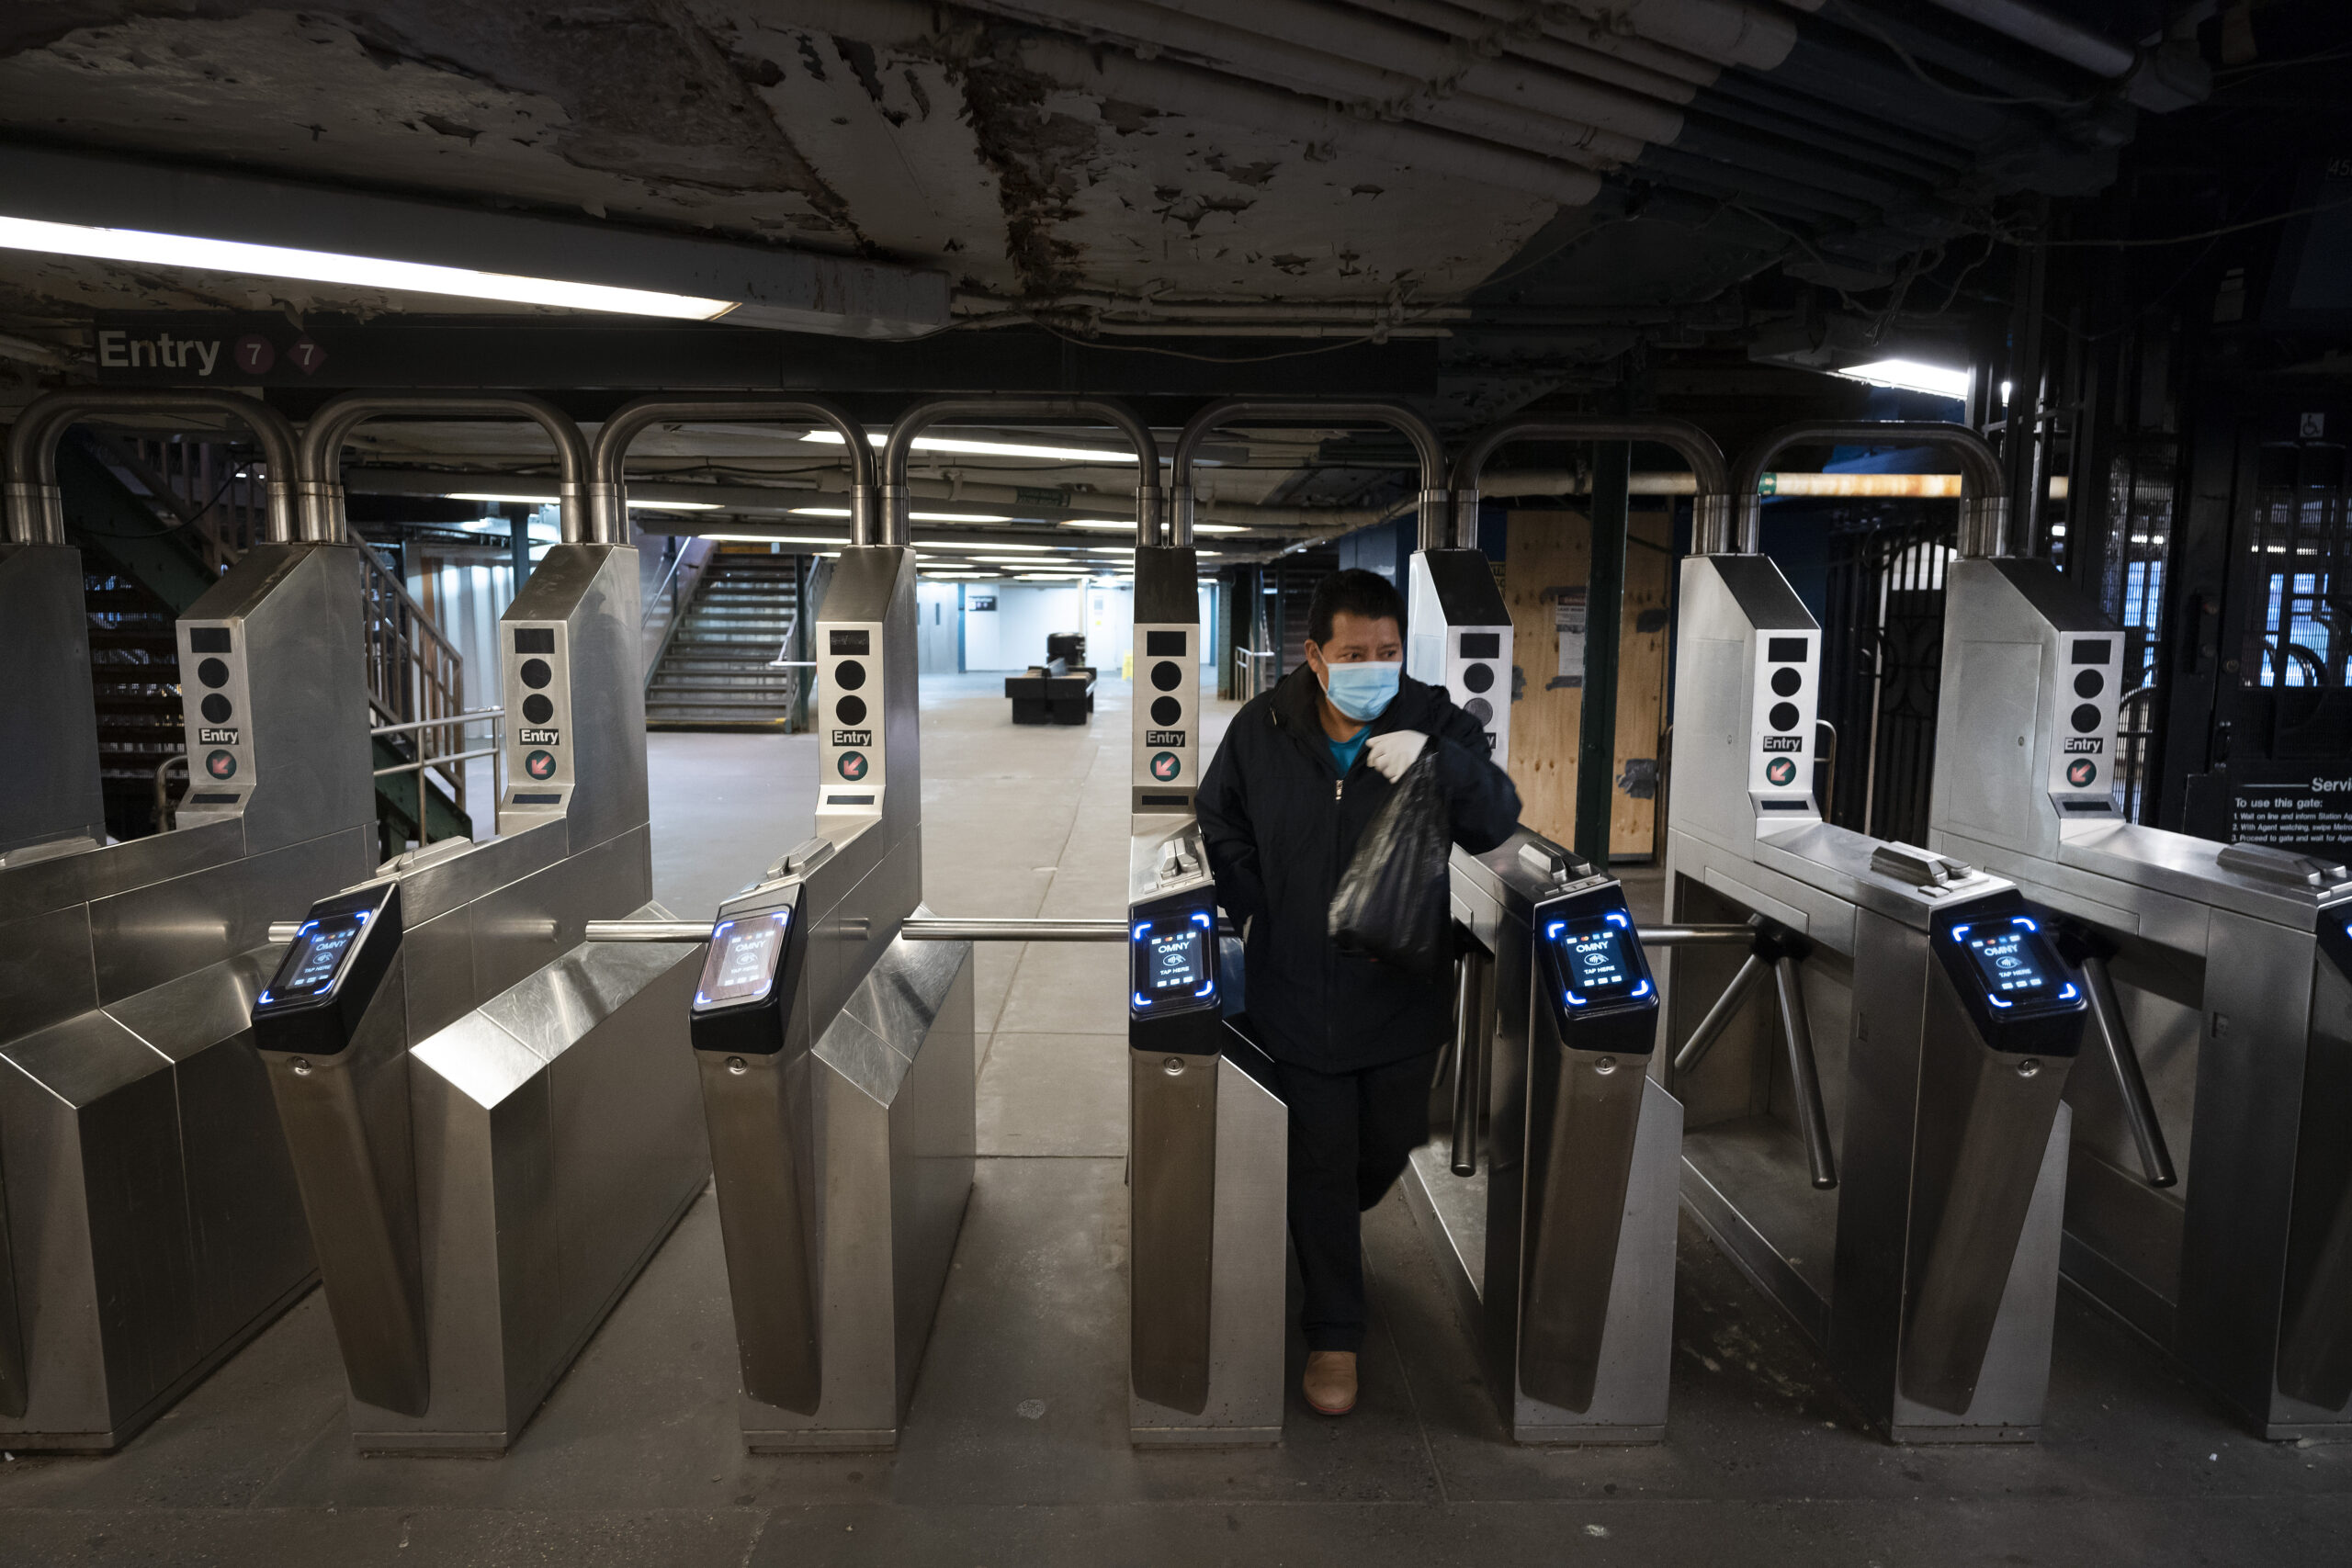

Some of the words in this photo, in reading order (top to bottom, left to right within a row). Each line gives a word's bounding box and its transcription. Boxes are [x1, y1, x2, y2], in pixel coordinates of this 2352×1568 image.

[98, 330, 221, 377] Entry
[246, 344, 262, 366] 7
[299, 344, 315, 366] 7
[201, 728, 238, 744] Entry
[521, 729, 559, 745] Entry
[833, 730, 871, 746] Entry
[1148, 731, 1184, 746] Entry
[1764, 737, 1800, 751] Entry
[2064, 738, 2100, 753] Entry
[2312, 777, 2352, 792] Servi
[2234, 797, 2247, 808] To
[2251, 799, 2270, 808] use
[2274, 797, 2293, 808] this
[2297, 798, 2323, 810] gate:
[2295, 812, 2316, 820] inform
[2318, 812, 2342, 820] Station
[2257, 823, 2278, 832] Agent
[2312, 823, 2332, 831] swipe
[2239, 834, 2267, 842] Proceed
[2278, 834, 2294, 843] gate
[2295, 834, 2309, 842] and
[2311, 834, 2324, 842] wait
[2326, 834, 2335, 842] for
[316, 940, 346, 951] OMNY
[735, 940, 765, 952] OMNY
[1158, 942, 1190, 953] OMNY
[1576, 941, 1609, 953] OMNY
[1984, 943, 2018, 956] OMNY
